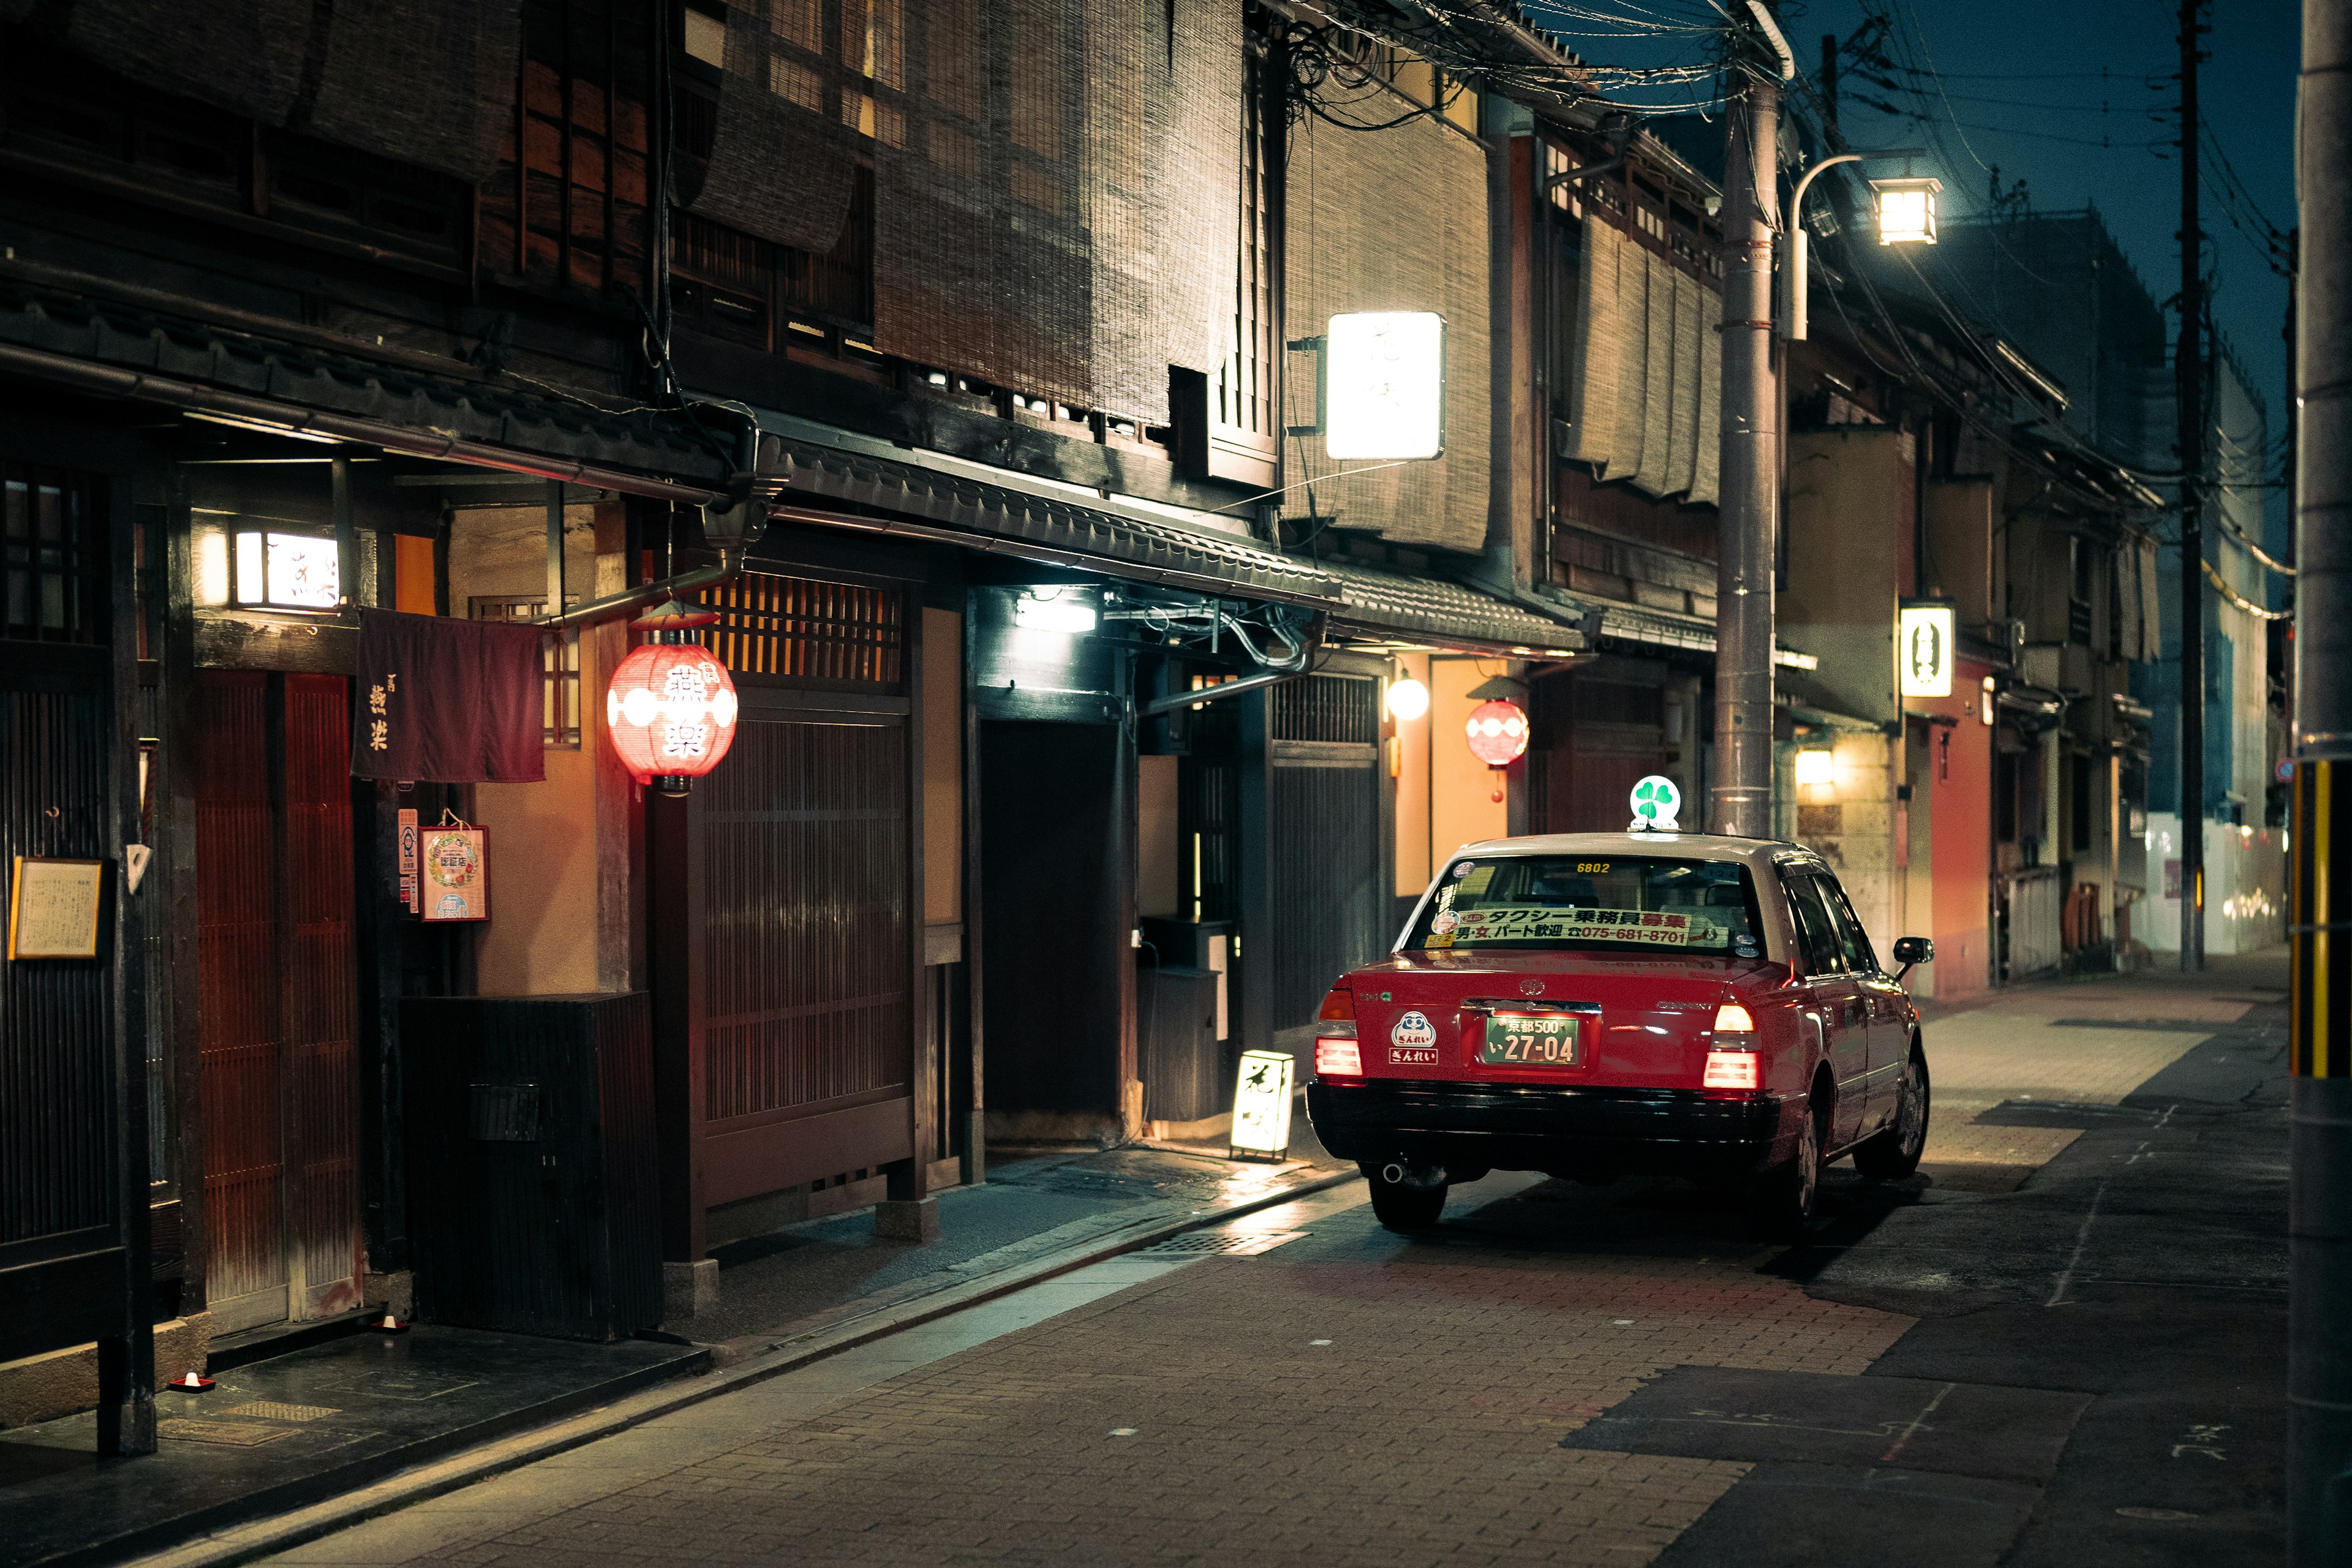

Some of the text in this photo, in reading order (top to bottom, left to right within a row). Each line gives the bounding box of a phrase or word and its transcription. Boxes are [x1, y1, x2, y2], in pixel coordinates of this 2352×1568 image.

[1577, 863, 1610, 873] 6802
[1488, 910, 1687, 929] タクシー乗務員募集
[1581, 926, 1686, 944] 075-681-8701
[1398, 1035, 1430, 1044] ぎんれい
[1391, 1049, 1436, 1062] ぎんれい
[1504, 1035, 1574, 1062] 27-04
